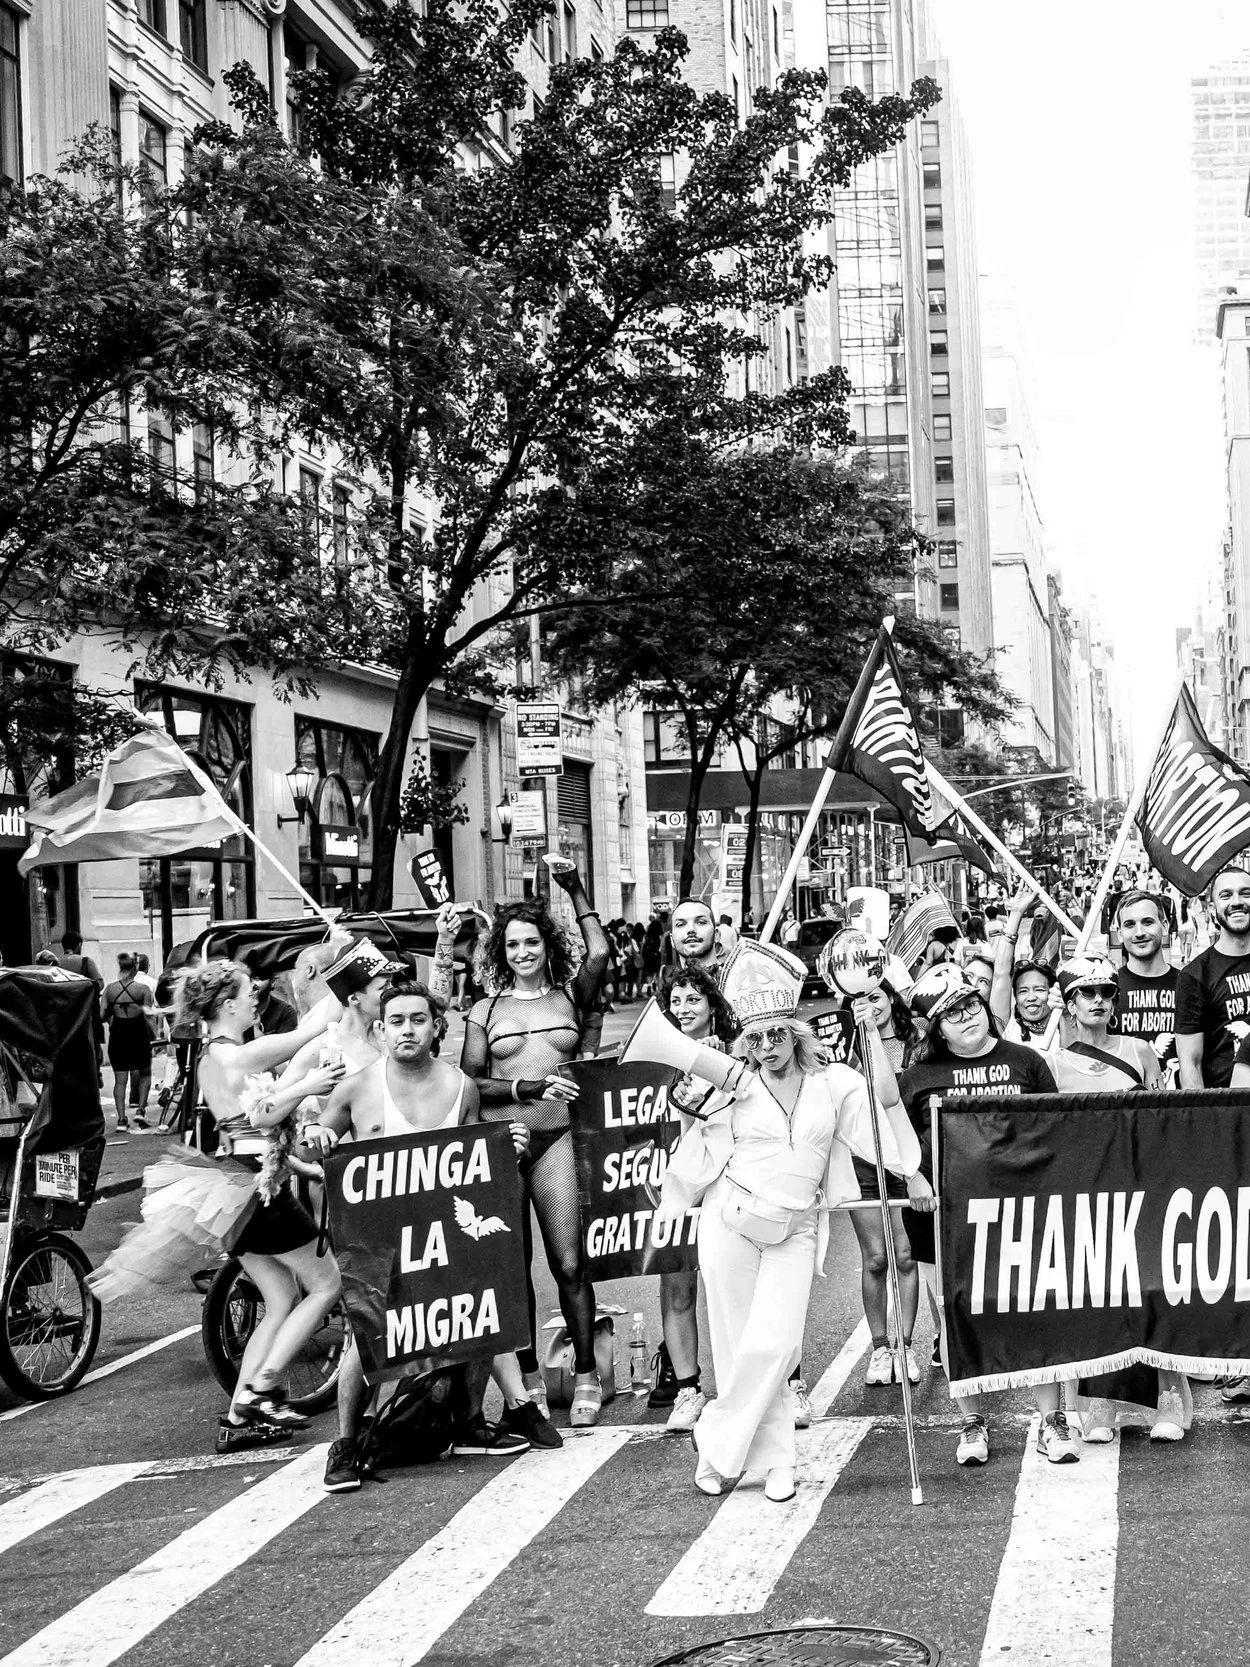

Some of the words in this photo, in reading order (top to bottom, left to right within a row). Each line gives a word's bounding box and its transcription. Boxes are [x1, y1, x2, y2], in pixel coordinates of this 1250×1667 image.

[511, 793, 518, 802] 3
[1128, 990, 1154, 1009] THANK
[1225, 999, 1244, 1020] FOR
[1122, 1013, 1139, 1032] FOR
[1141, 1012, 1175, 1033] ABORTI
[953, 1067, 987, 1085] THANK
[989, 1064, 1010, 1082] GOD
[59, 1153, 70, 1164] PER
[603, 1145, 672, 1192] SEGU
[40, 1171, 55, 1184] RIDE
[343, 1138, 491, 1204] CHINGA
[587, 1206, 699, 1258] GRATUIT
[400, 1220, 449, 1274] LA
[967, 1191, 1146, 1314] THANK
[386, 1288, 500, 1358] MIGRA
